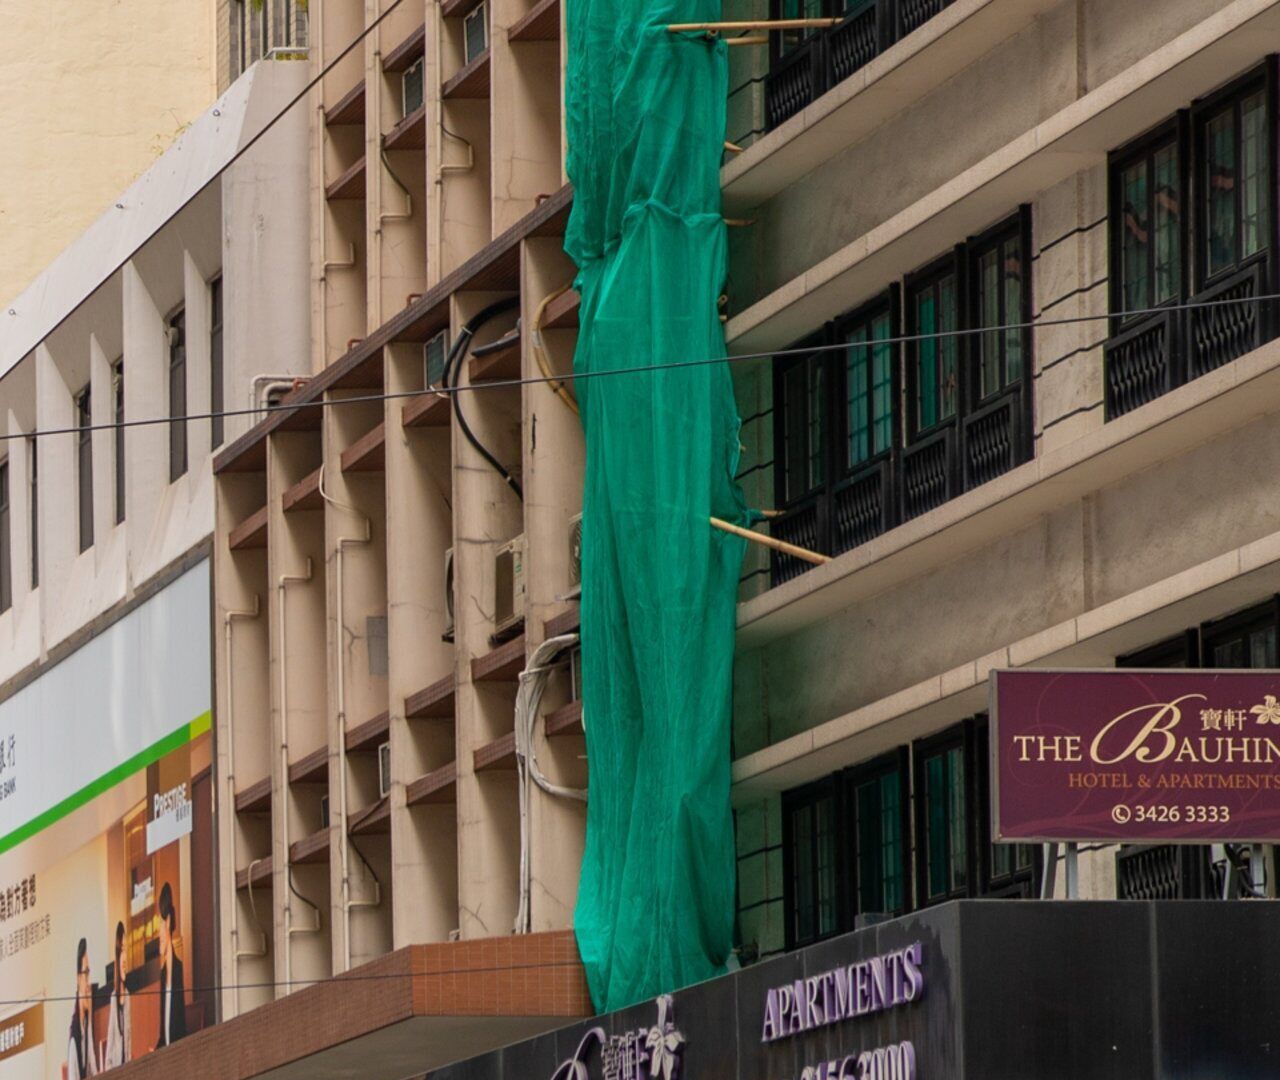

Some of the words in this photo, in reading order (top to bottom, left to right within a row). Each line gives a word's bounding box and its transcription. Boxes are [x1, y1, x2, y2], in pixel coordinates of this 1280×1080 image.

[1199, 708, 1247, 732] 寶軒
[1013, 735, 1082, 762] THE
[1068, 773, 1132, 788] HOTEL
[1137, 773, 1151, 788] &
[1156, 774, 1280, 790] APARTMENTS
[154, 782, 187, 820] PRESTIGE
[1134, 805, 1180, 822] 3426
[1185, 805, 1230, 822] 3333
[761, 940, 924, 1043] APARTMENTS
